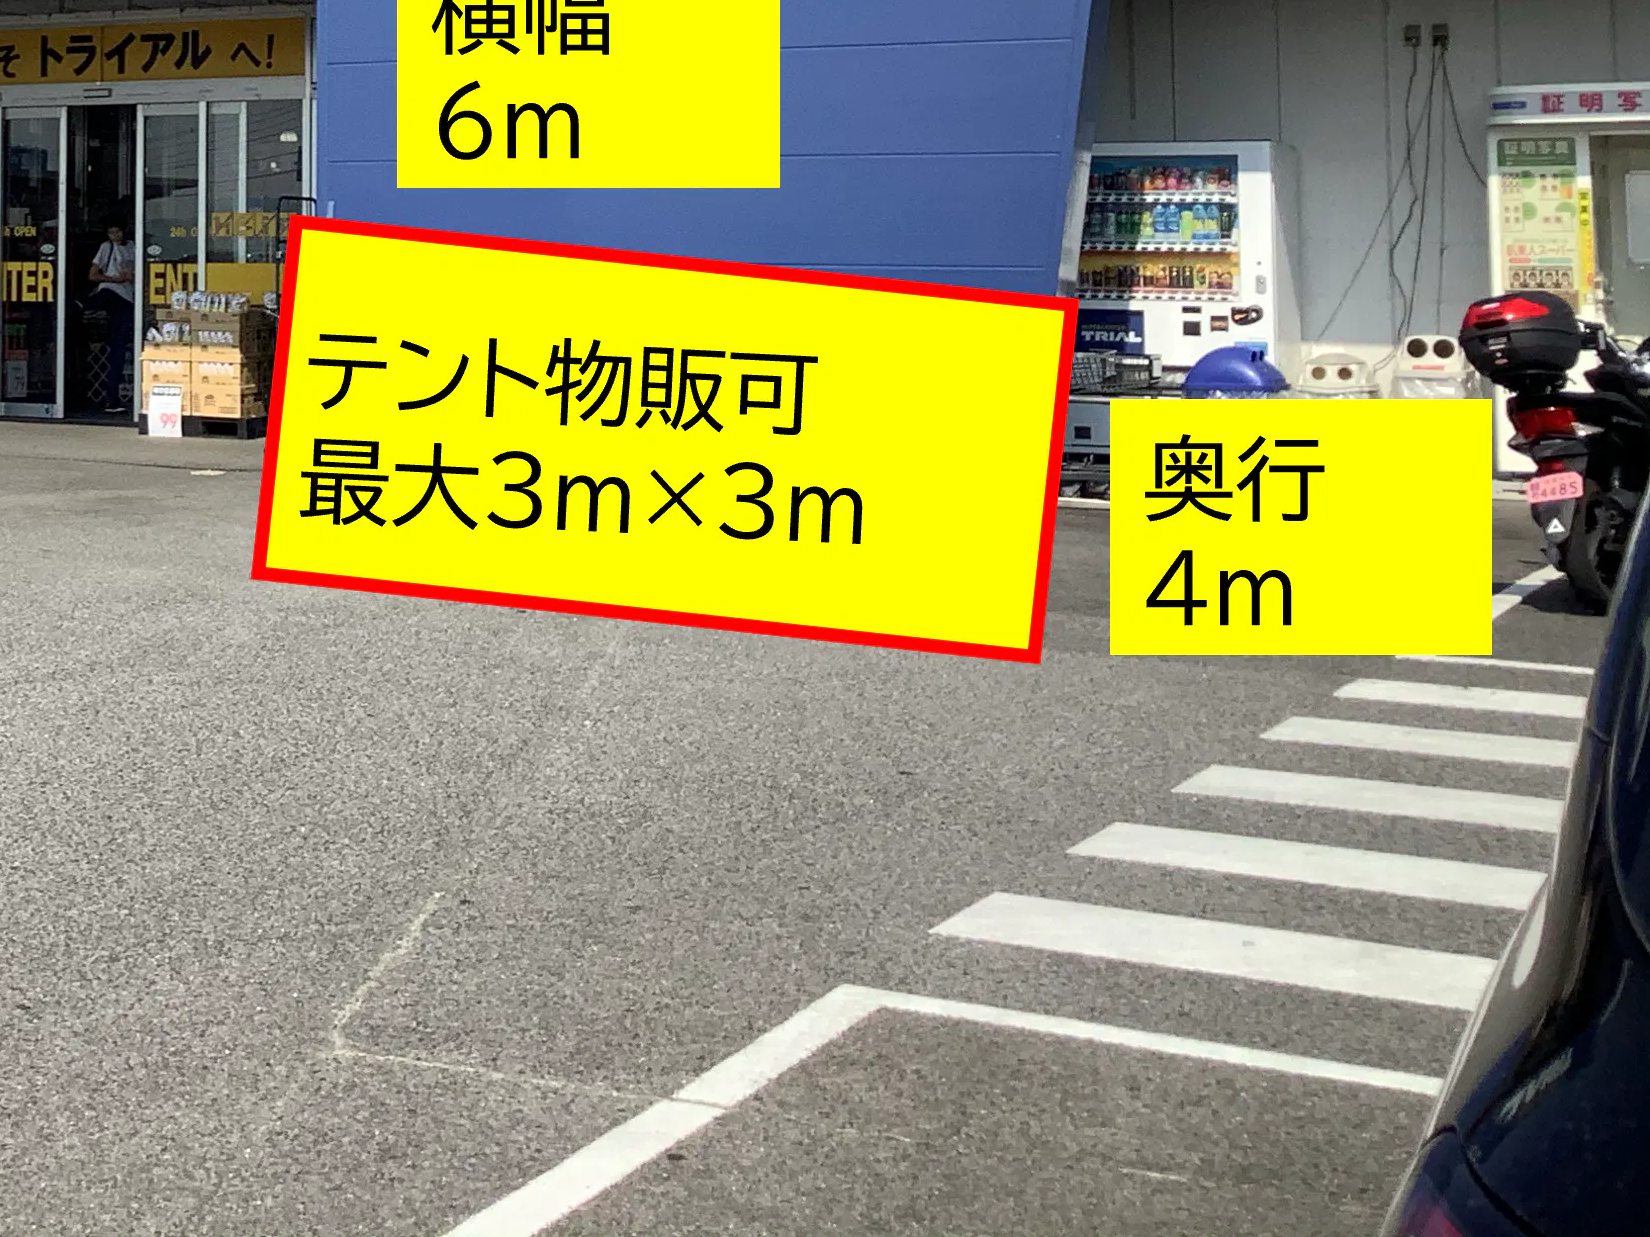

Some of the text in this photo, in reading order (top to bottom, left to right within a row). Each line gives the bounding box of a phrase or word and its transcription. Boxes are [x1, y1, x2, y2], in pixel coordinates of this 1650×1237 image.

[14, 225, 37, 237] OPEN
[2, 261, 55, 303] TER
[150, 262, 198, 304] ENT
[1081, 330, 1142, 343] TRIAL
